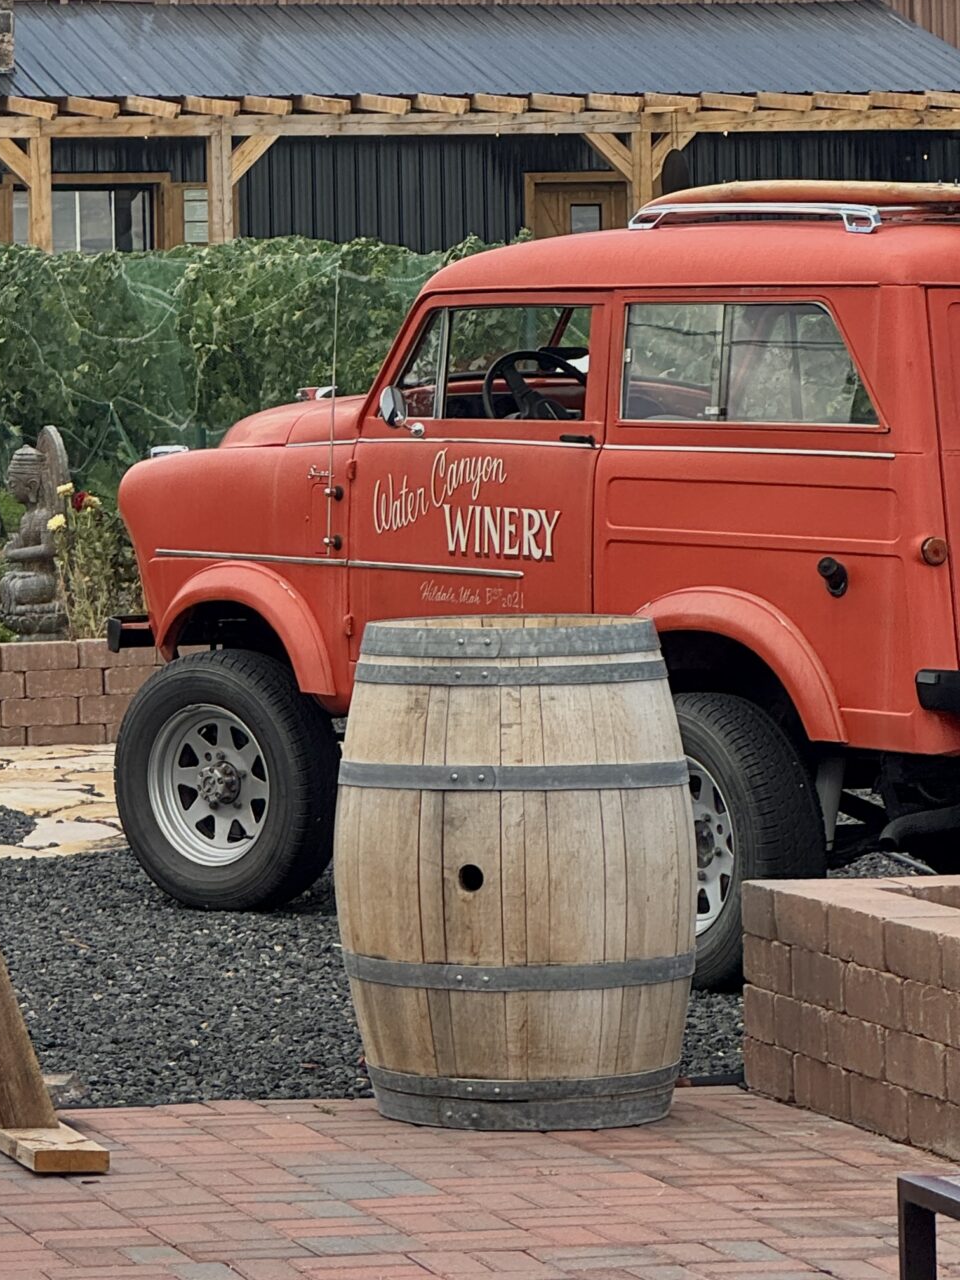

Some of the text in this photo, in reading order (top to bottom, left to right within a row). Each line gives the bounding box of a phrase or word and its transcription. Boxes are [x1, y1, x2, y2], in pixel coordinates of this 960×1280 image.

[373, 448, 507, 534] Water Canyon
[443, 504, 560, 561] WINERY
[502, 591, 524, 609] 2021
